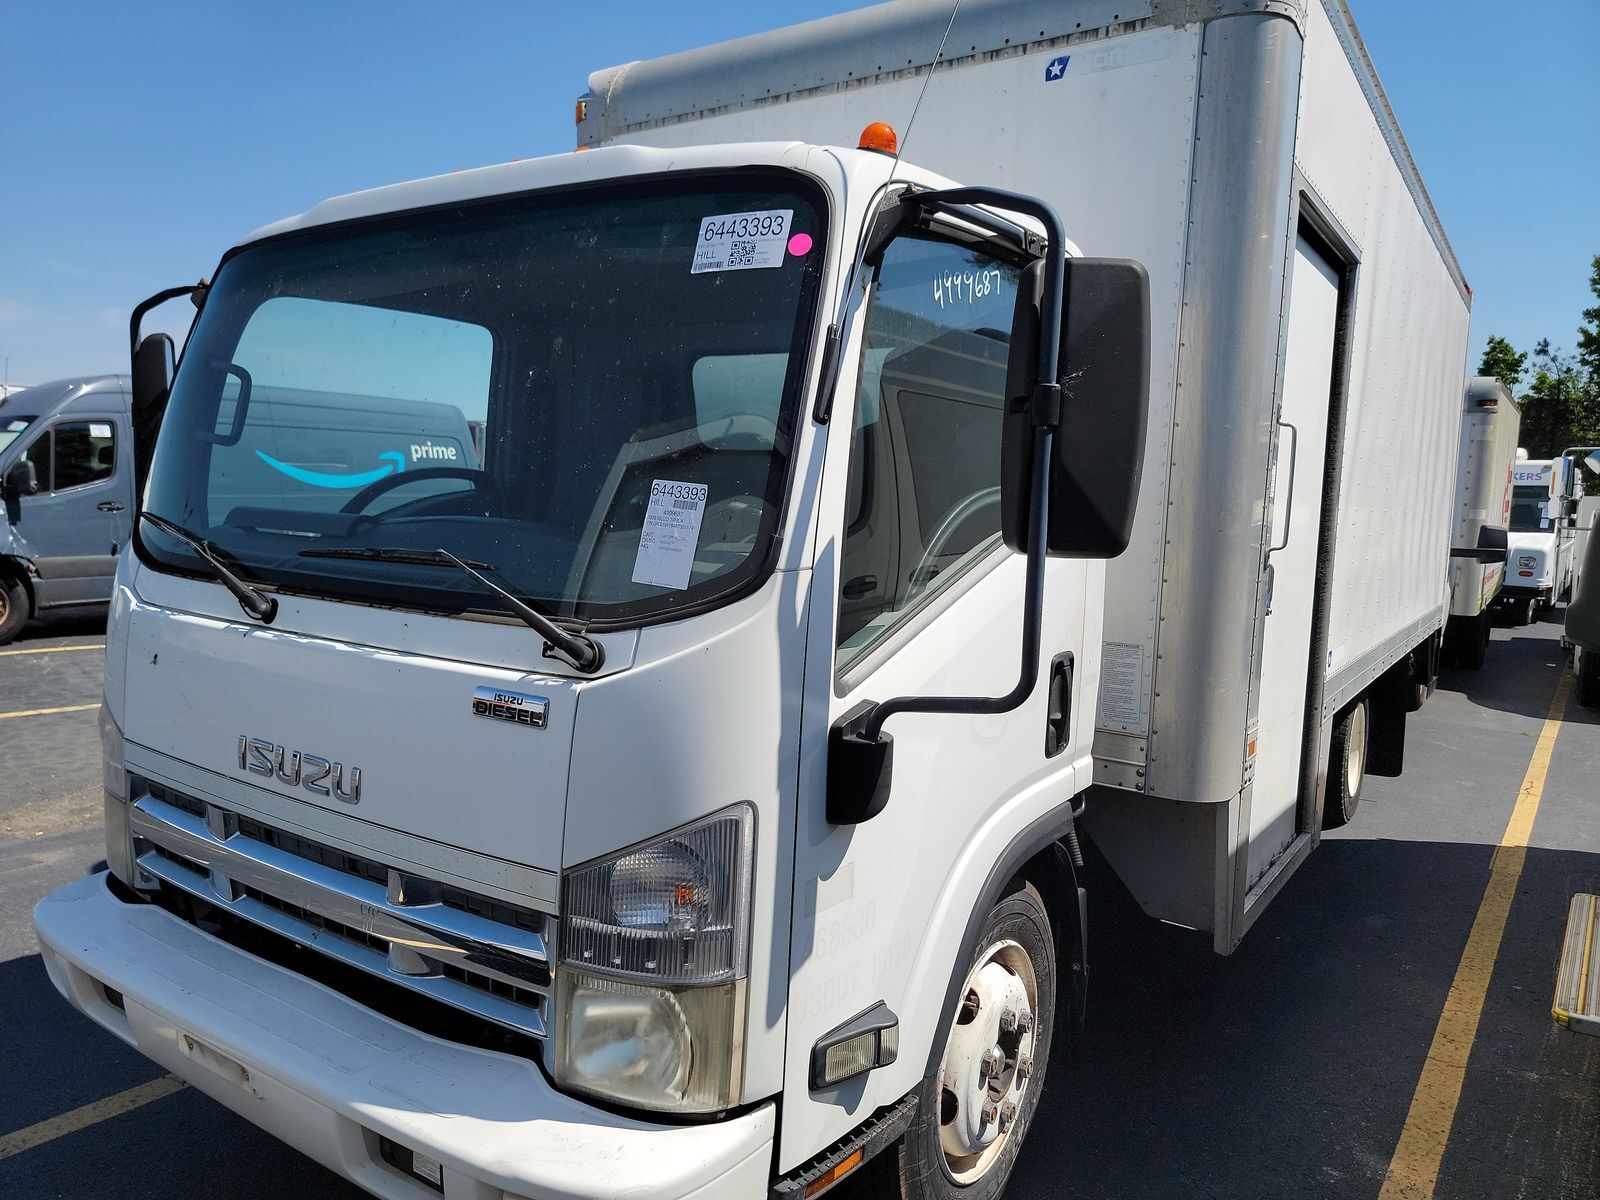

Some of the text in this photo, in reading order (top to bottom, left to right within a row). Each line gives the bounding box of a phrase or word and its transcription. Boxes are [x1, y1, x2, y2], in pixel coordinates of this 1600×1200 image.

[704, 215, 785, 241] 6443393
[696, 250, 717, 260] HILL
[934, 268, 1001, 310] 4999687
[410, 441, 457, 462] prime
[652, 483, 706, 501] 6443393
[651, 499, 664, 507] HILL
[493, 693, 524, 706] ISUZU
[475, 700, 545, 728] DIESEL
[237, 734, 362, 805] ISUZU
